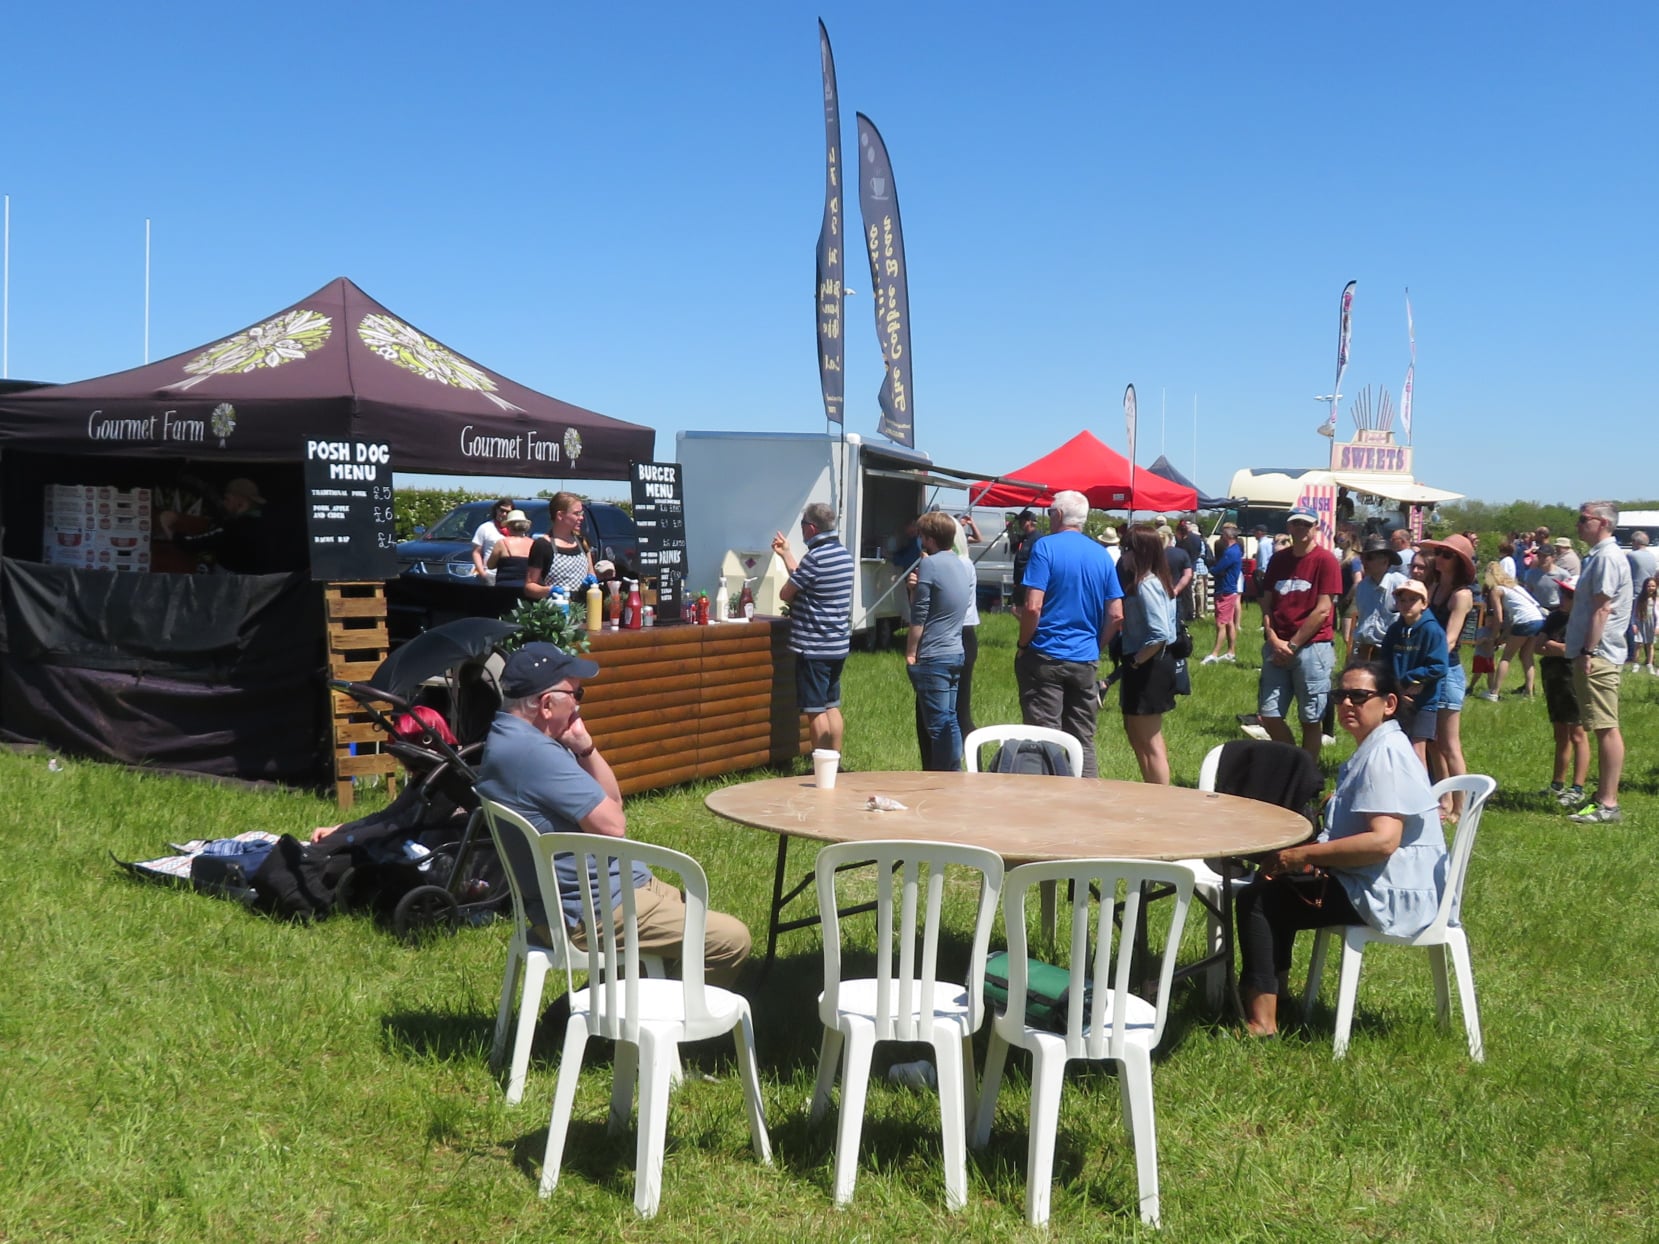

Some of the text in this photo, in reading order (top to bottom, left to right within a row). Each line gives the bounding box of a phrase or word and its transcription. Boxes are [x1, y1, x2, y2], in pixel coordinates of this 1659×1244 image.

[88, 410, 205, 441] Gourmet Farm
[307, 440, 390, 464] POSH DOG
[461, 425, 560, 462] Gourmet Farm
[1340, 446, 1405, 470] SWEETS
[329, 464, 377, 480] MENU
[638, 463, 676, 483] BURGER
[645, 483, 674, 498] MENU
